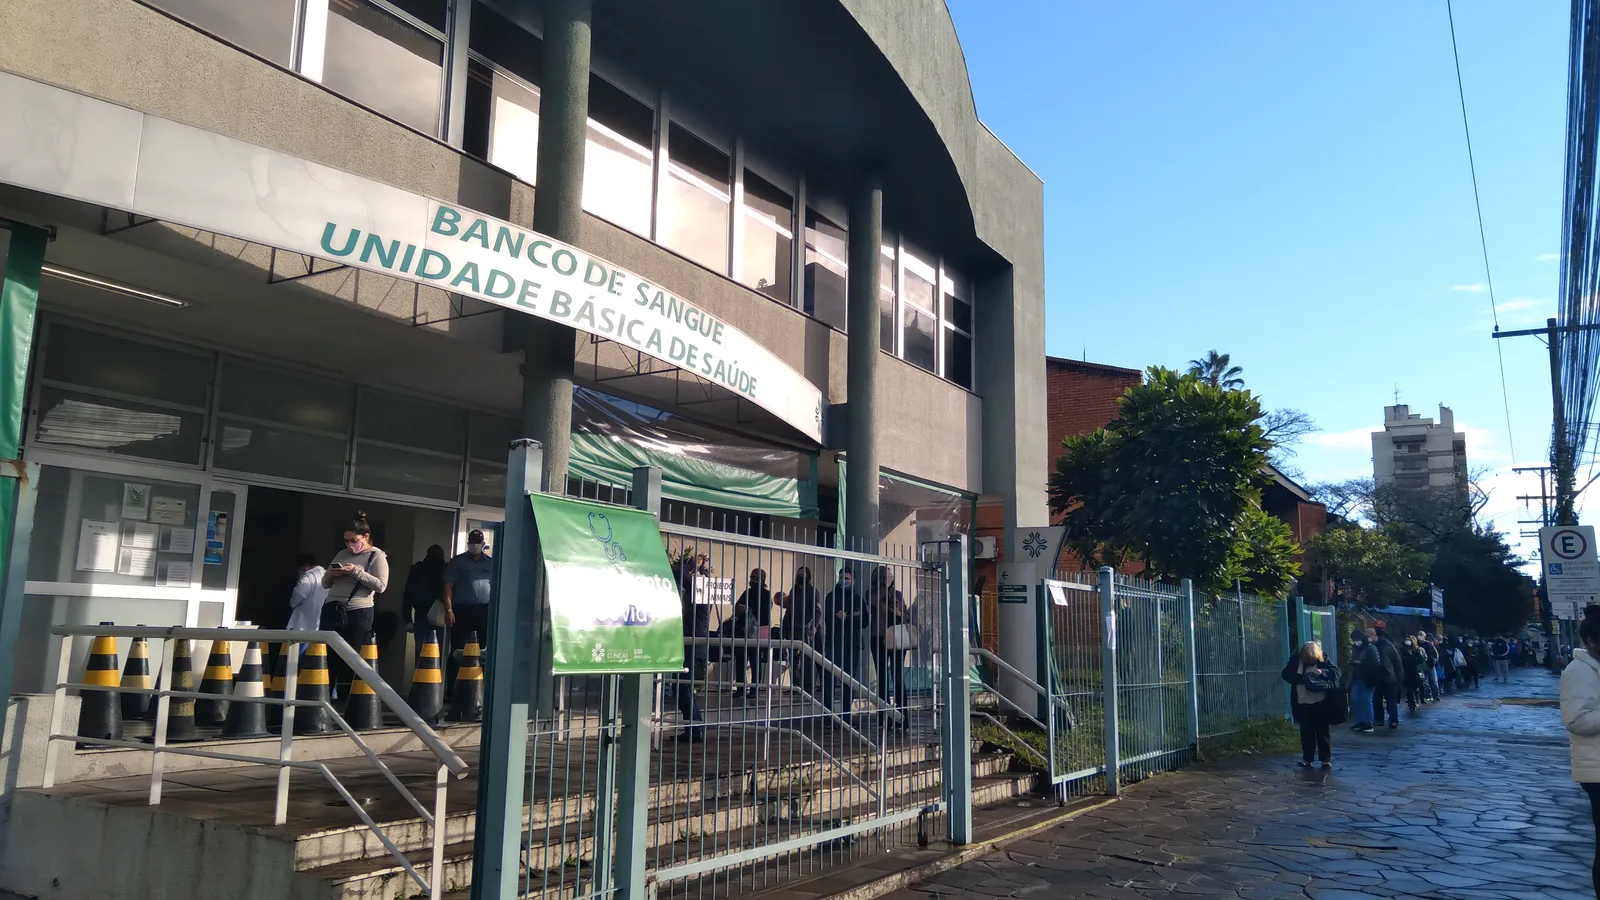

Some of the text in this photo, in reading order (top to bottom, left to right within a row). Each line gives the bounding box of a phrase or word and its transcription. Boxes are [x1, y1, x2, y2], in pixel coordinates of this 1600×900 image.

[320, 222, 758, 399] UNIDADE BÁSICA DE SAÚDE
[431, 205, 726, 345] BANCO DE SANGUE
[1562, 536, 1576, 553] E
[706, 581, 733, 590] PROIBDO
